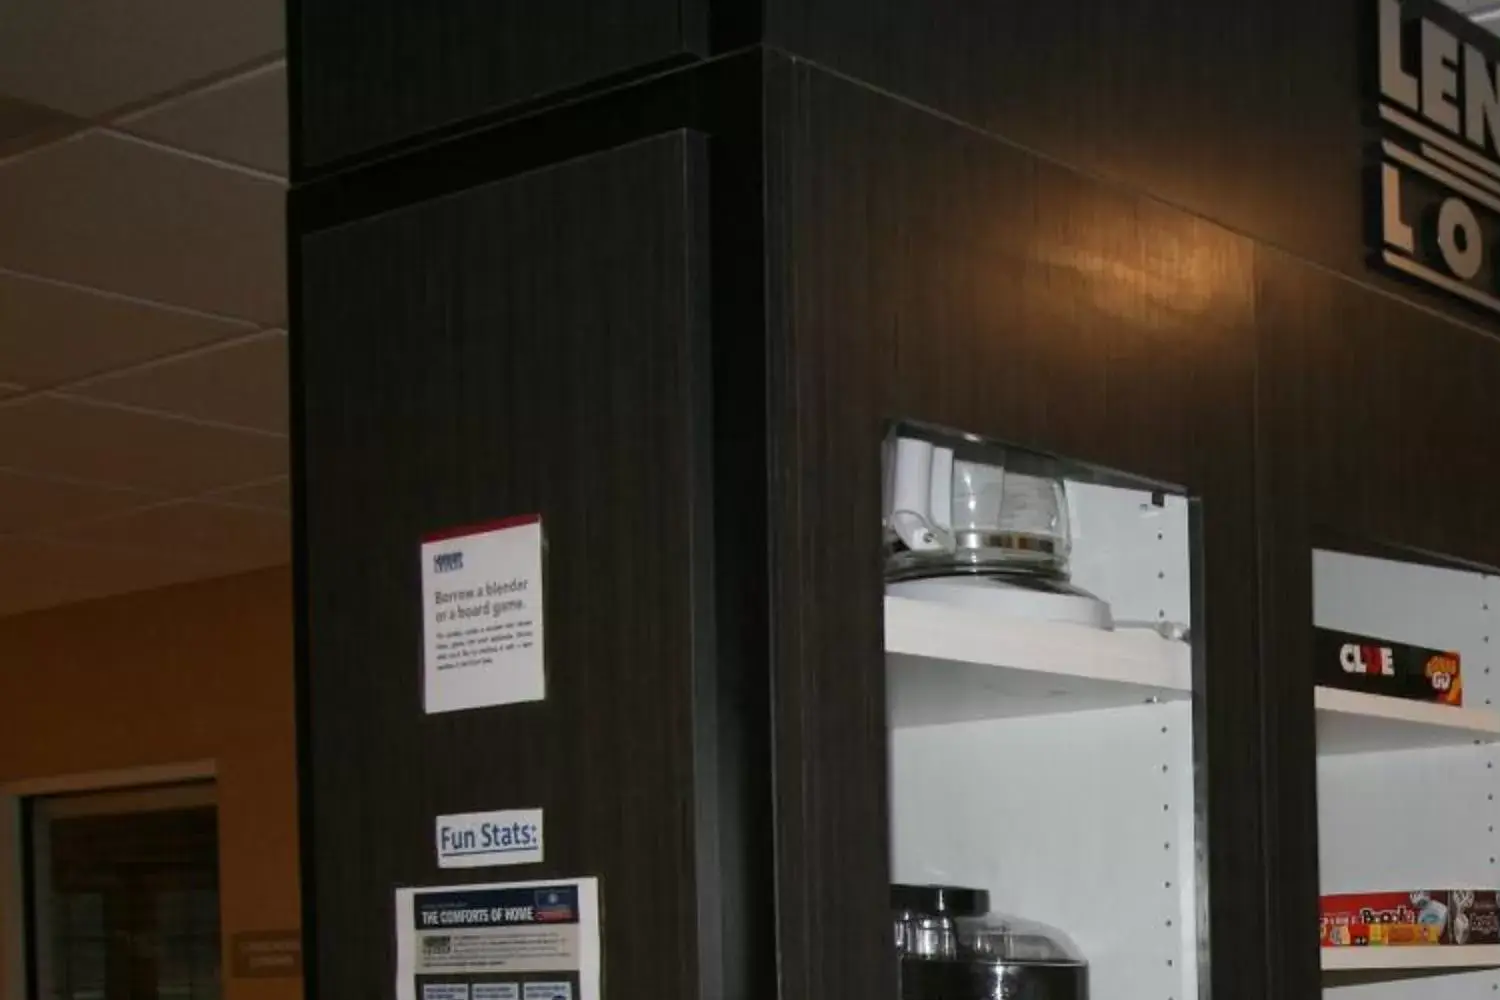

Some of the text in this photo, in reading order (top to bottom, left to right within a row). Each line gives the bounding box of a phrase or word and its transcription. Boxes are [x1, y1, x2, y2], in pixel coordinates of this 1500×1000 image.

[485, 578, 529, 597] blender
[457, 602, 490, 620] board
[1339, 643, 1396, 676] CLUE
[441, 820, 537, 851] Fun Stats:
[422, 905, 535, 925] THE COMFORTS OF HOME
